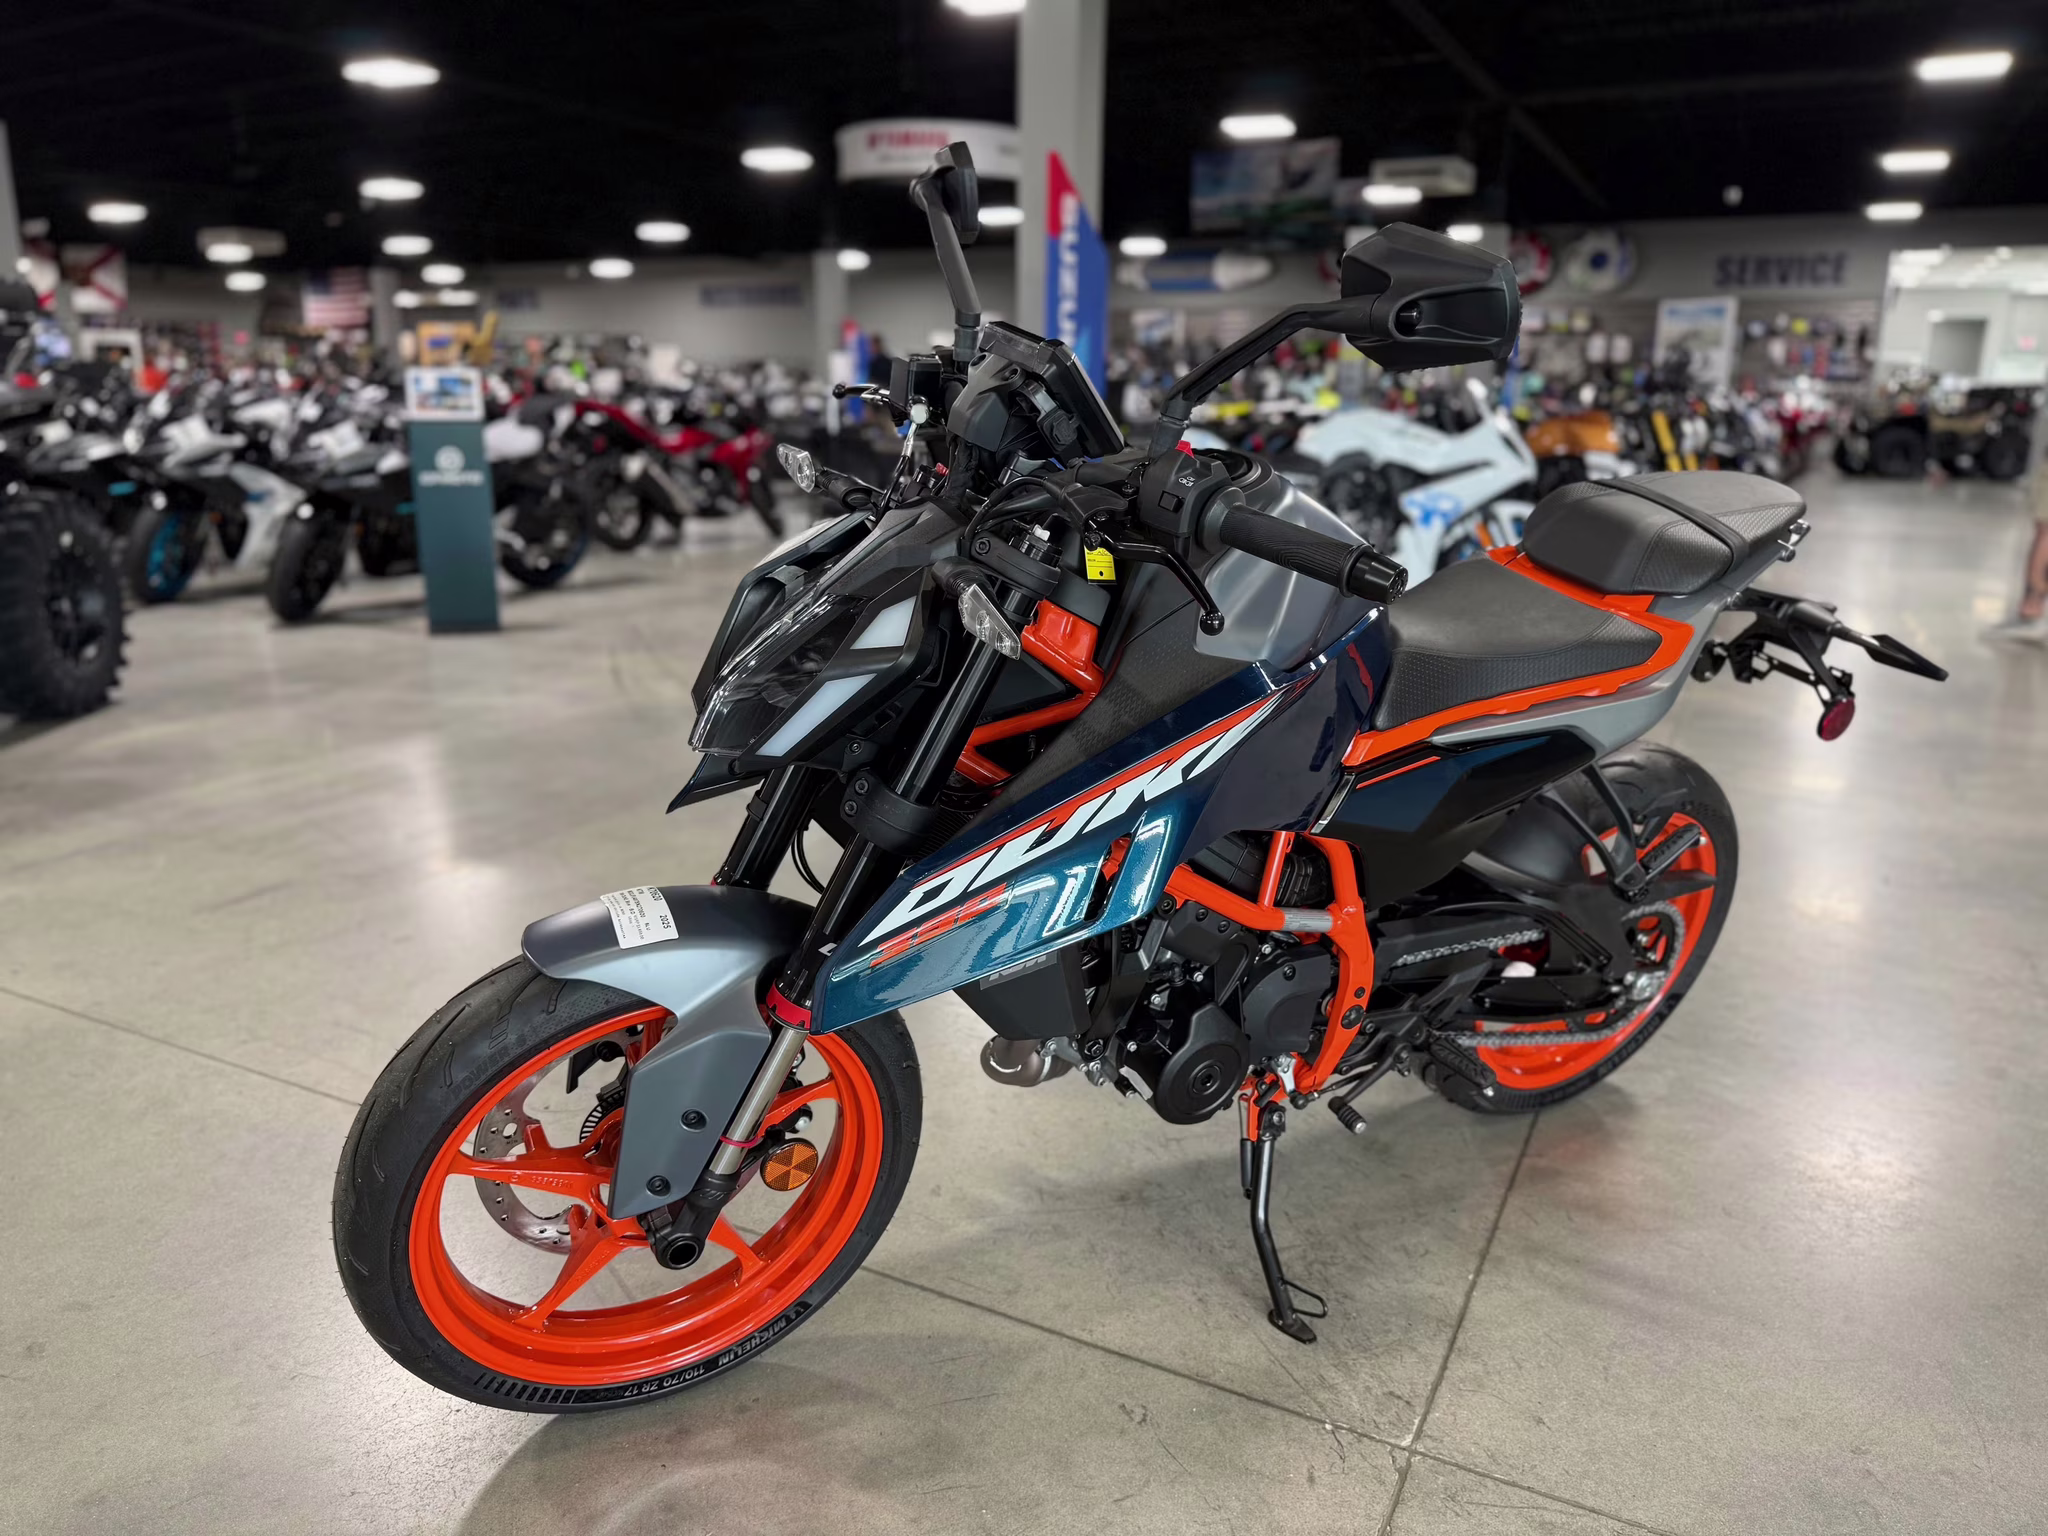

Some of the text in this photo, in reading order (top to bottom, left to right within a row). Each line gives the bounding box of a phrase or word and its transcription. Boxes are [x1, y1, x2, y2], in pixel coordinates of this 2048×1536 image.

[1714, 254, 1847, 287] SERVICE
[858, 692, 1284, 947] DUKE
[659, 914, 671, 930] 2025
[716, 1315, 787, 1367] MICHELIN
[641, 1380, 660, 1392] ZR
[663, 1364, 706, 1386] 110/70
[623, 1385, 640, 1397] 17
